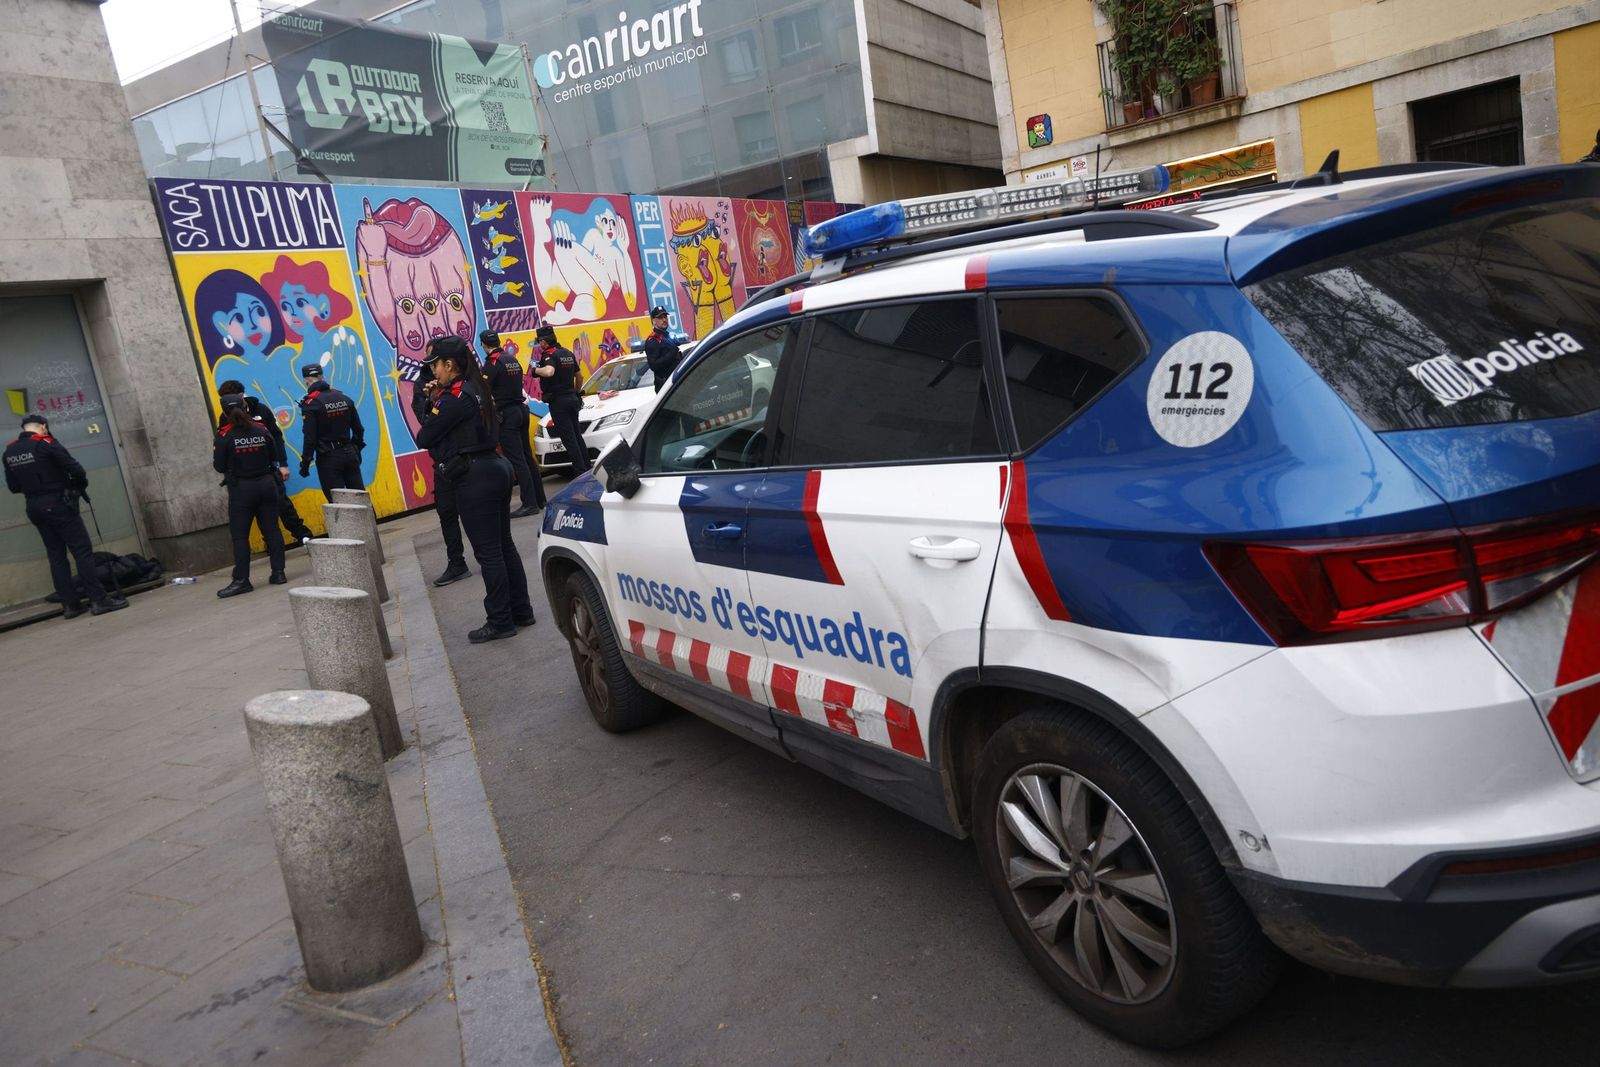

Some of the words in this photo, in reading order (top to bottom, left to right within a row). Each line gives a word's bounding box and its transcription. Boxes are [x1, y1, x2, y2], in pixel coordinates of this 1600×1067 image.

[547, 0, 704, 85] canricart
[350, 64, 422, 93] OUTDOOR
[455, 72, 496, 86] RESERVA
[554, 79, 592, 103] centre
[593, 63, 642, 90] esportiu
[644, 41, 708, 75] municipal
[356, 89, 433, 136] BOX
[165, 182, 210, 248] SACA
[199, 184, 250, 248] TU
[245, 185, 343, 248] PLUMA
[634, 201, 660, 221] PER
[1462, 331, 1585, 387] policia
[1163, 361, 1234, 400] 112
[325, 400, 348, 410] POLICIA
[1161, 403, 1226, 418] emergències
[6, 452, 34, 464] POLICIA
[234, 436, 266, 446] POLICIA
[560, 513, 584, 529] policia
[616, 571, 707, 623] mossos
[711, 586, 913, 679] d'esquadra
